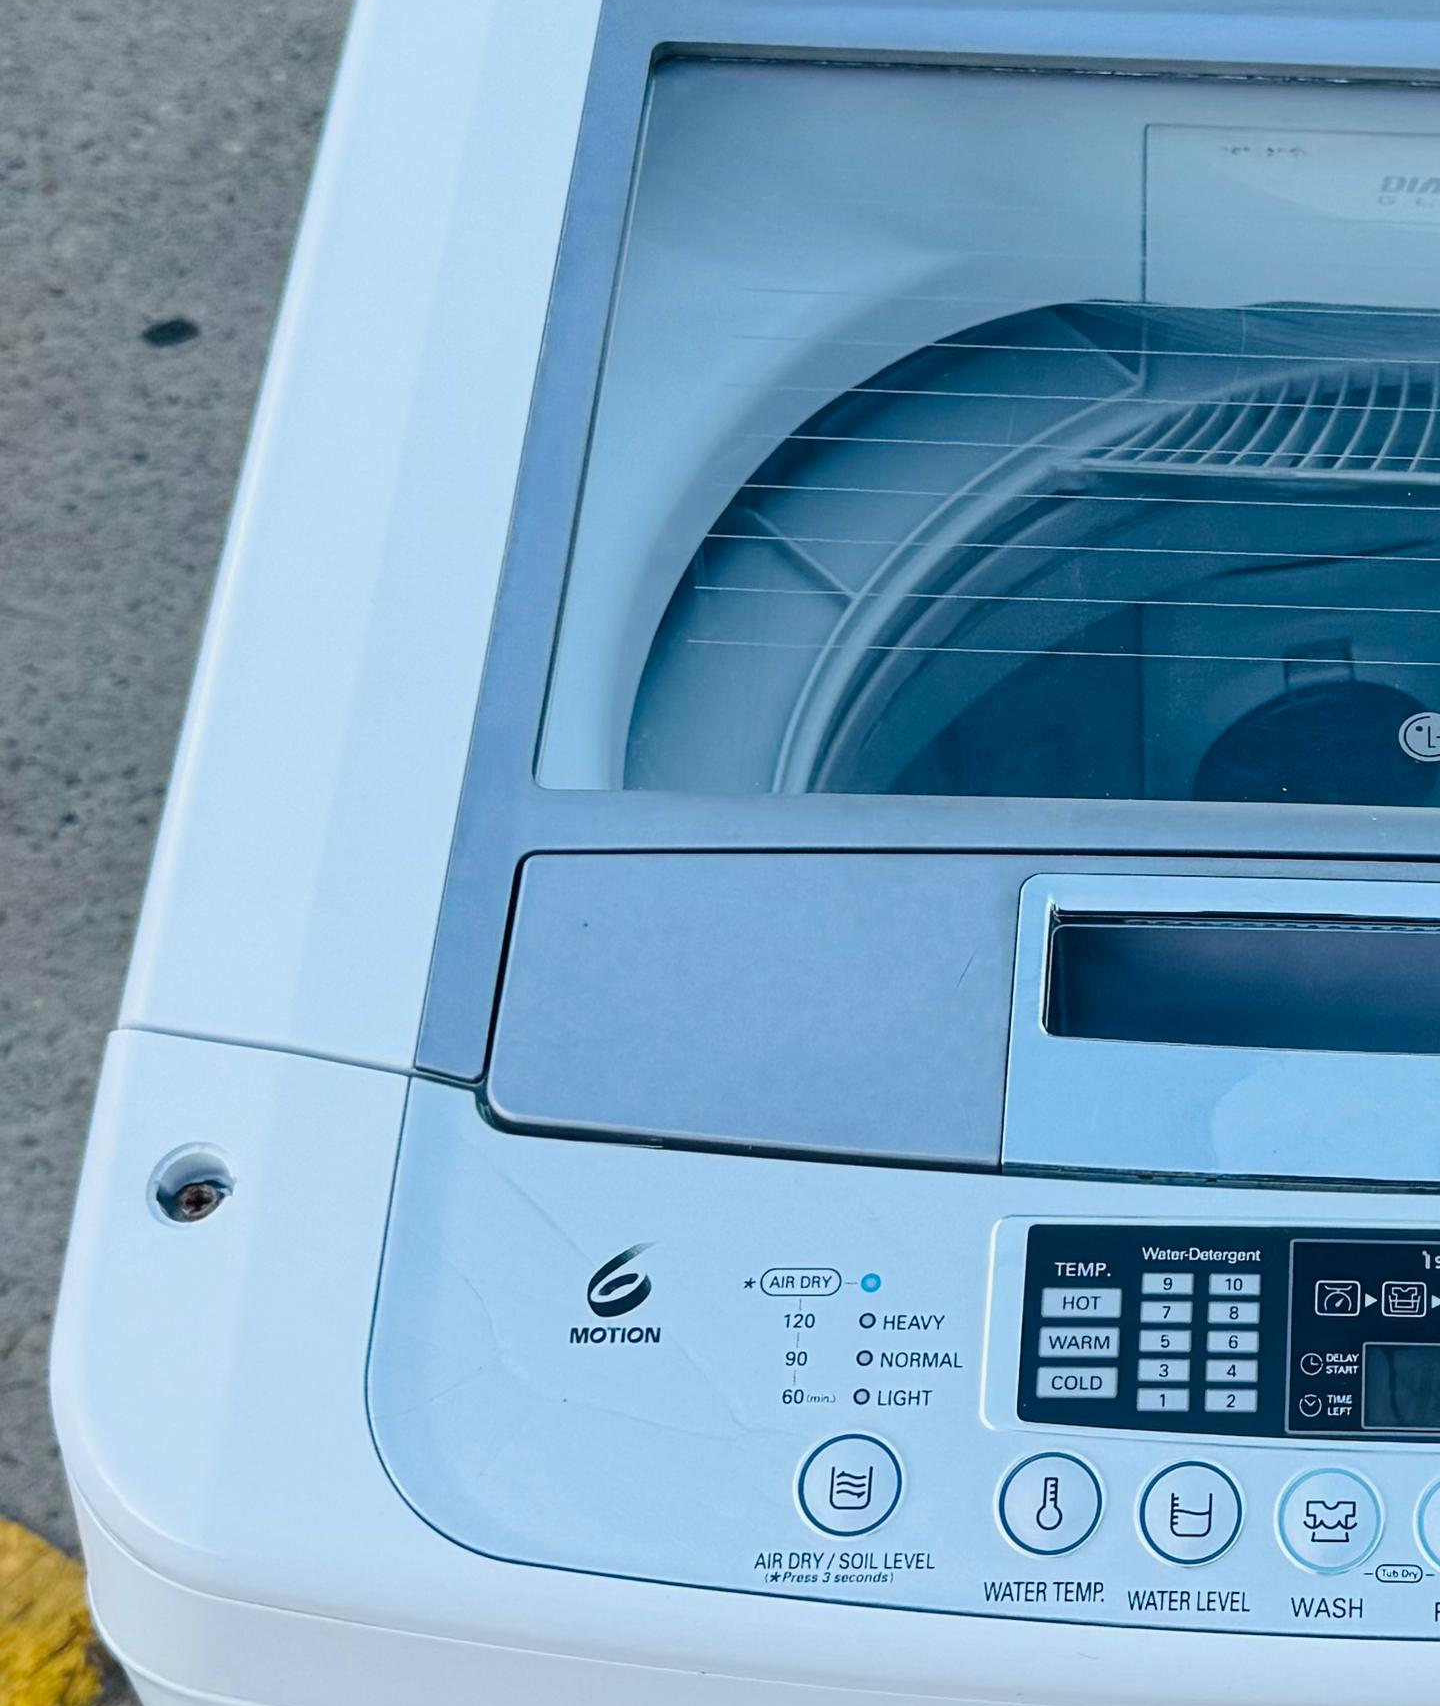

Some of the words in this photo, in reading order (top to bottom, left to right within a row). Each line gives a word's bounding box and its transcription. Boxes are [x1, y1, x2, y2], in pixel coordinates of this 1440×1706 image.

[1142, 1246, 1262, 1264] Water-Detergent
[1055, 1262, 1112, 1278] TEMP.
[769, 1276, 795, 1289] AIR
[800, 1276, 832, 1289] DRY
[1163, 1278, 1173, 1291] 9
[1225, 1278, 1243, 1291] 10
[1062, 1295, 1101, 1310] HOT
[1162, 1306, 1171, 1319] 7
[1229, 1306, 1239, 1319] 8
[783, 1313, 816, 1329] 120
[883, 1315, 946, 1330] HEAVY
[569, 1326, 661, 1344] MOTION
[1160, 1335, 1170, 1348] 5
[1228, 1335, 1239, 1349] 6
[1049, 1335, 1110, 1350] WARM
[785, 1351, 808, 1367] 90
[880, 1352, 964, 1368] NORMAL
[1326, 1353, 1359, 1363] DELAY
[1159, 1364, 1169, 1378] 3
[1226, 1364, 1237, 1378] 4
[1326, 1364, 1359, 1375] START
[1051, 1375, 1103, 1390] COLD
[781, 1389, 804, 1405] 60
[877, 1390, 933, 1406] LIGHT
[1159, 1394, 1166, 1408] 1
[1226, 1394, 1236, 1408] 2
[1327, 1395, 1352, 1404] TIME
[1327, 1406, 1352, 1416] LEFT
[754, 1552, 783, 1570] AIR
[788, 1552, 825, 1570] DRY
[839, 1552, 878, 1570] SOIL
[884, 1553, 936, 1570] LEVEL
[822, 1571, 831, 1583] 3
[1382, 1569, 1398, 1577] Tub
[1402, 1570, 1418, 1580] Dry
[984, 1581, 1047, 1602] WATER
[1054, 1582, 1105, 1602] TEMP.
[1128, 1590, 1190, 1611] WATER
[1197, 1592, 1250, 1612] LEVEL
[1291, 1597, 1363, 1619] WASH
